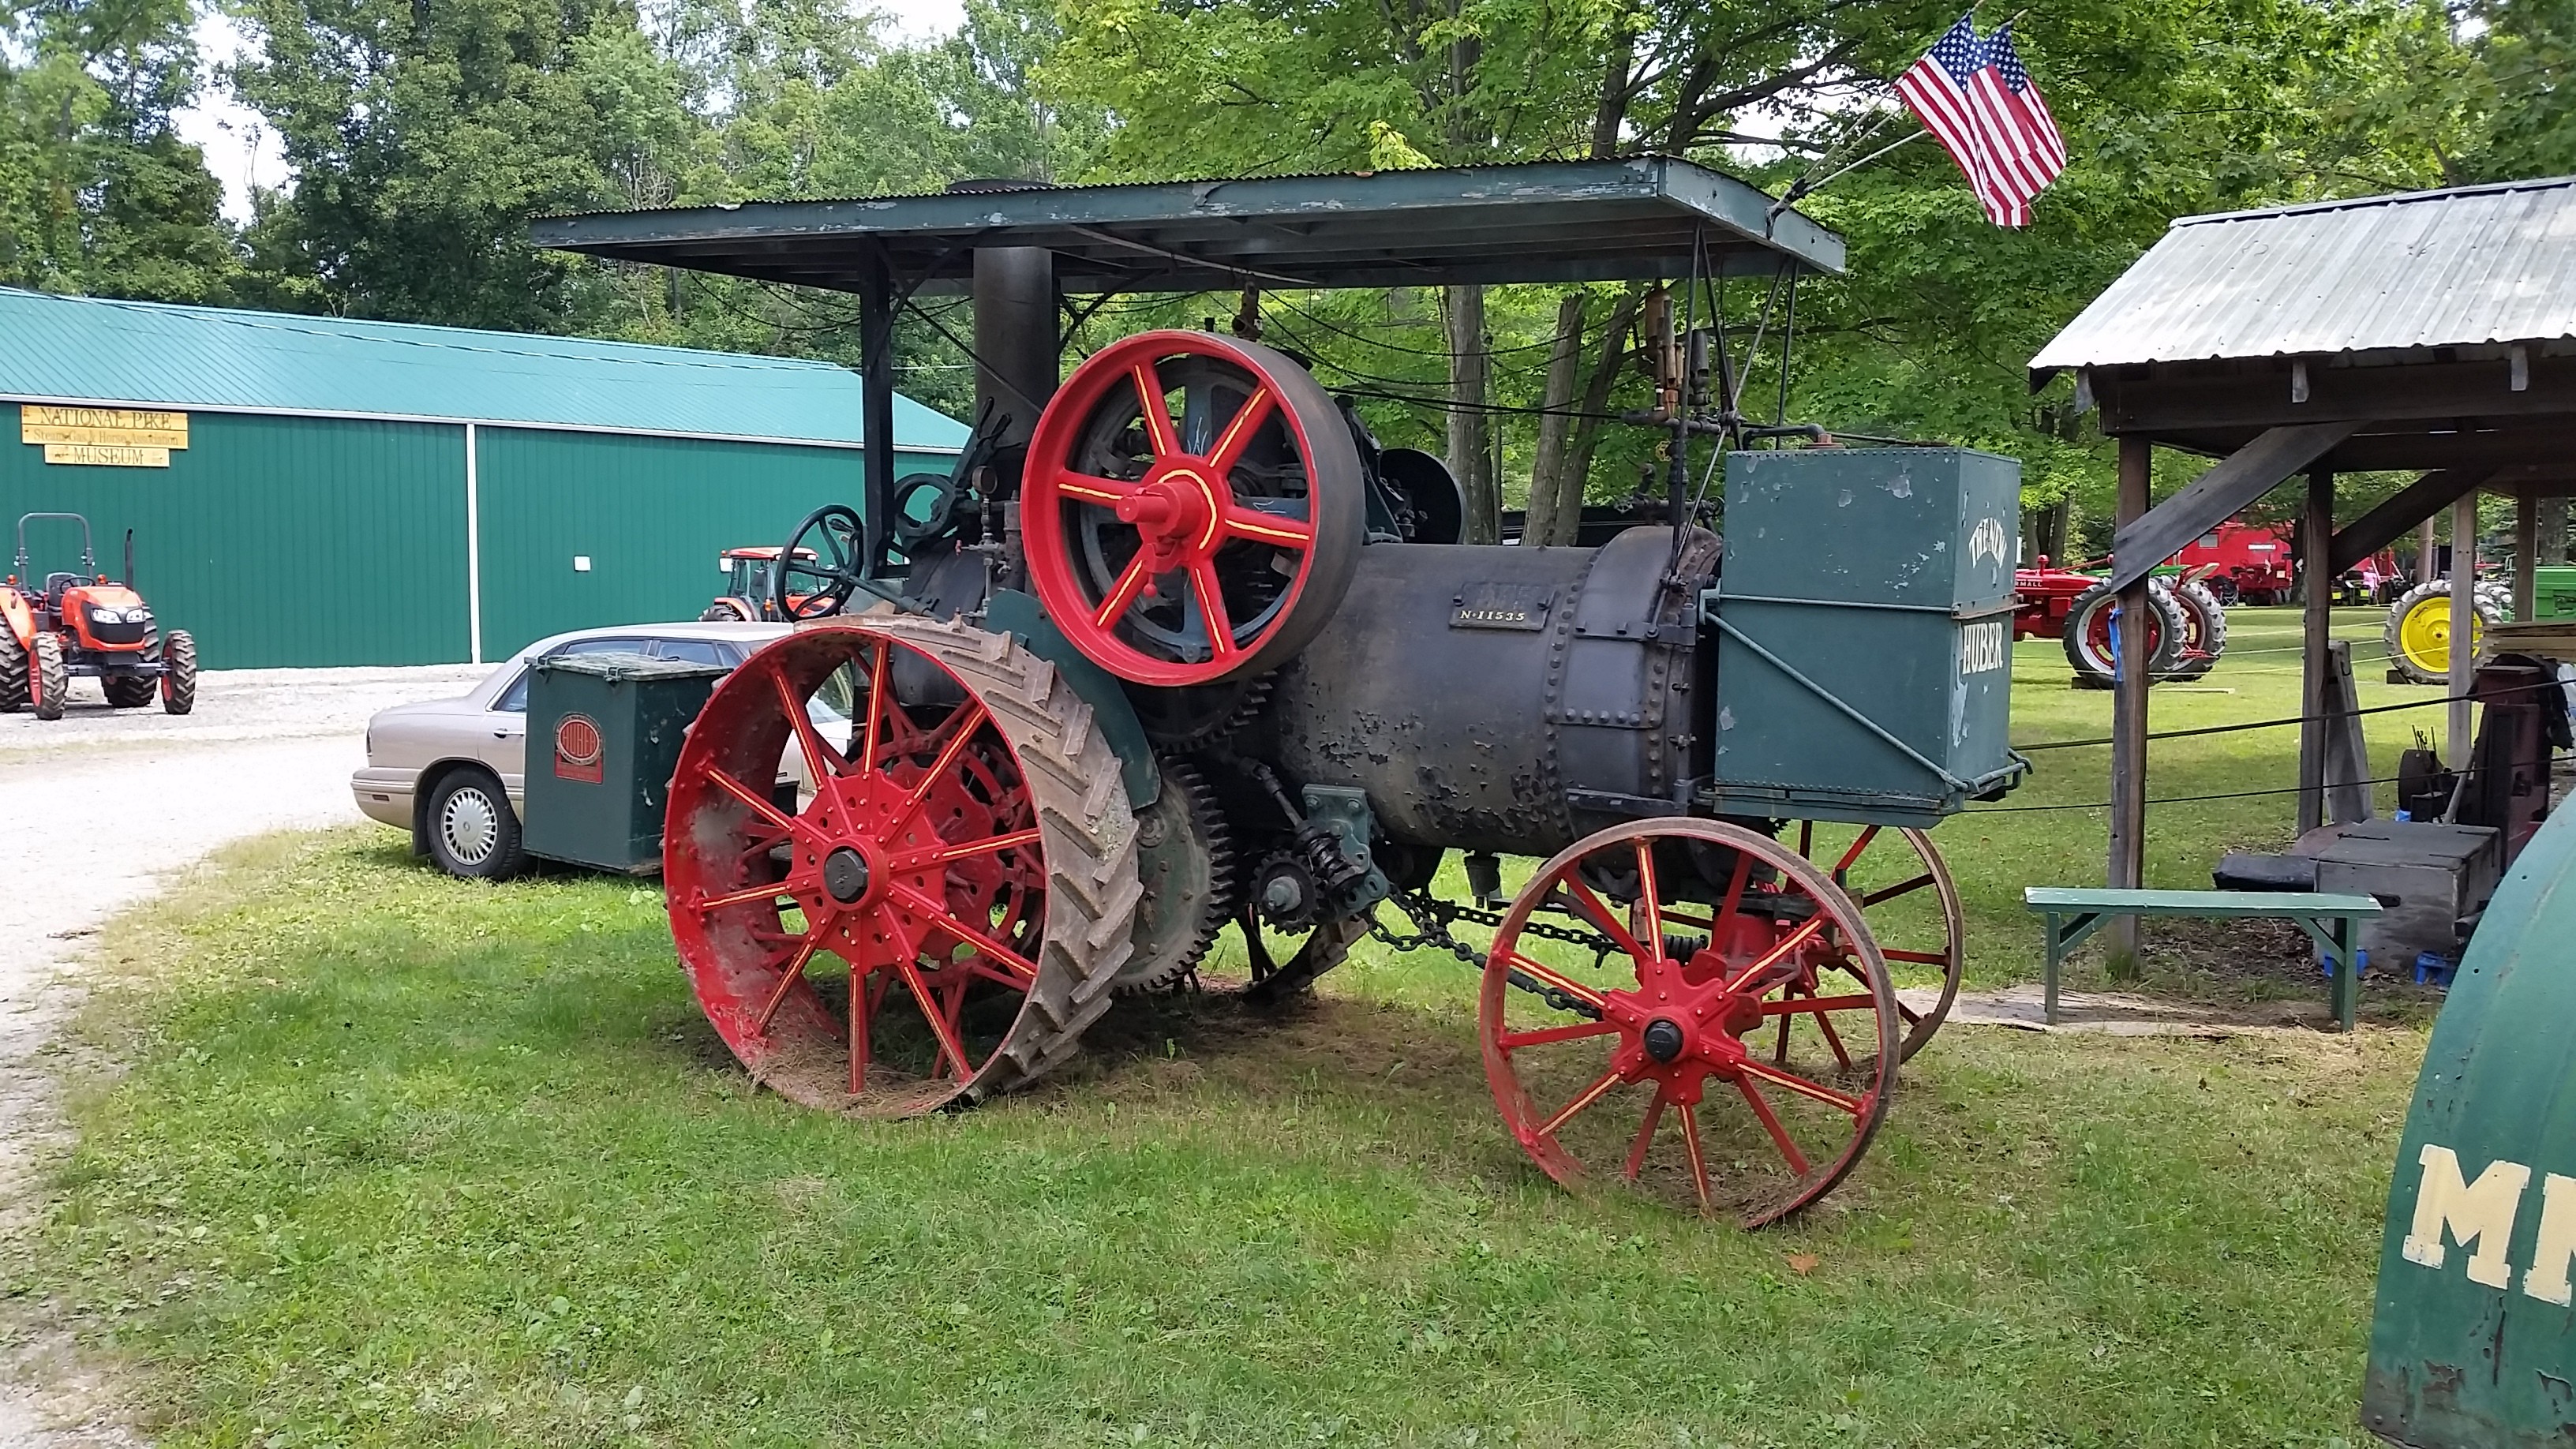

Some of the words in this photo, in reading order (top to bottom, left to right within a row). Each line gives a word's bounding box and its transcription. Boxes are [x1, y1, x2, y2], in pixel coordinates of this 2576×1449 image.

[39, 407, 125, 428] NATIONAL
[132, 412, 170, 429] PIKE
[74, 447, 143, 464] MUSEUM
[1962, 622, 2003, 675] HUBER
[562, 723, 597, 757] HUBER
